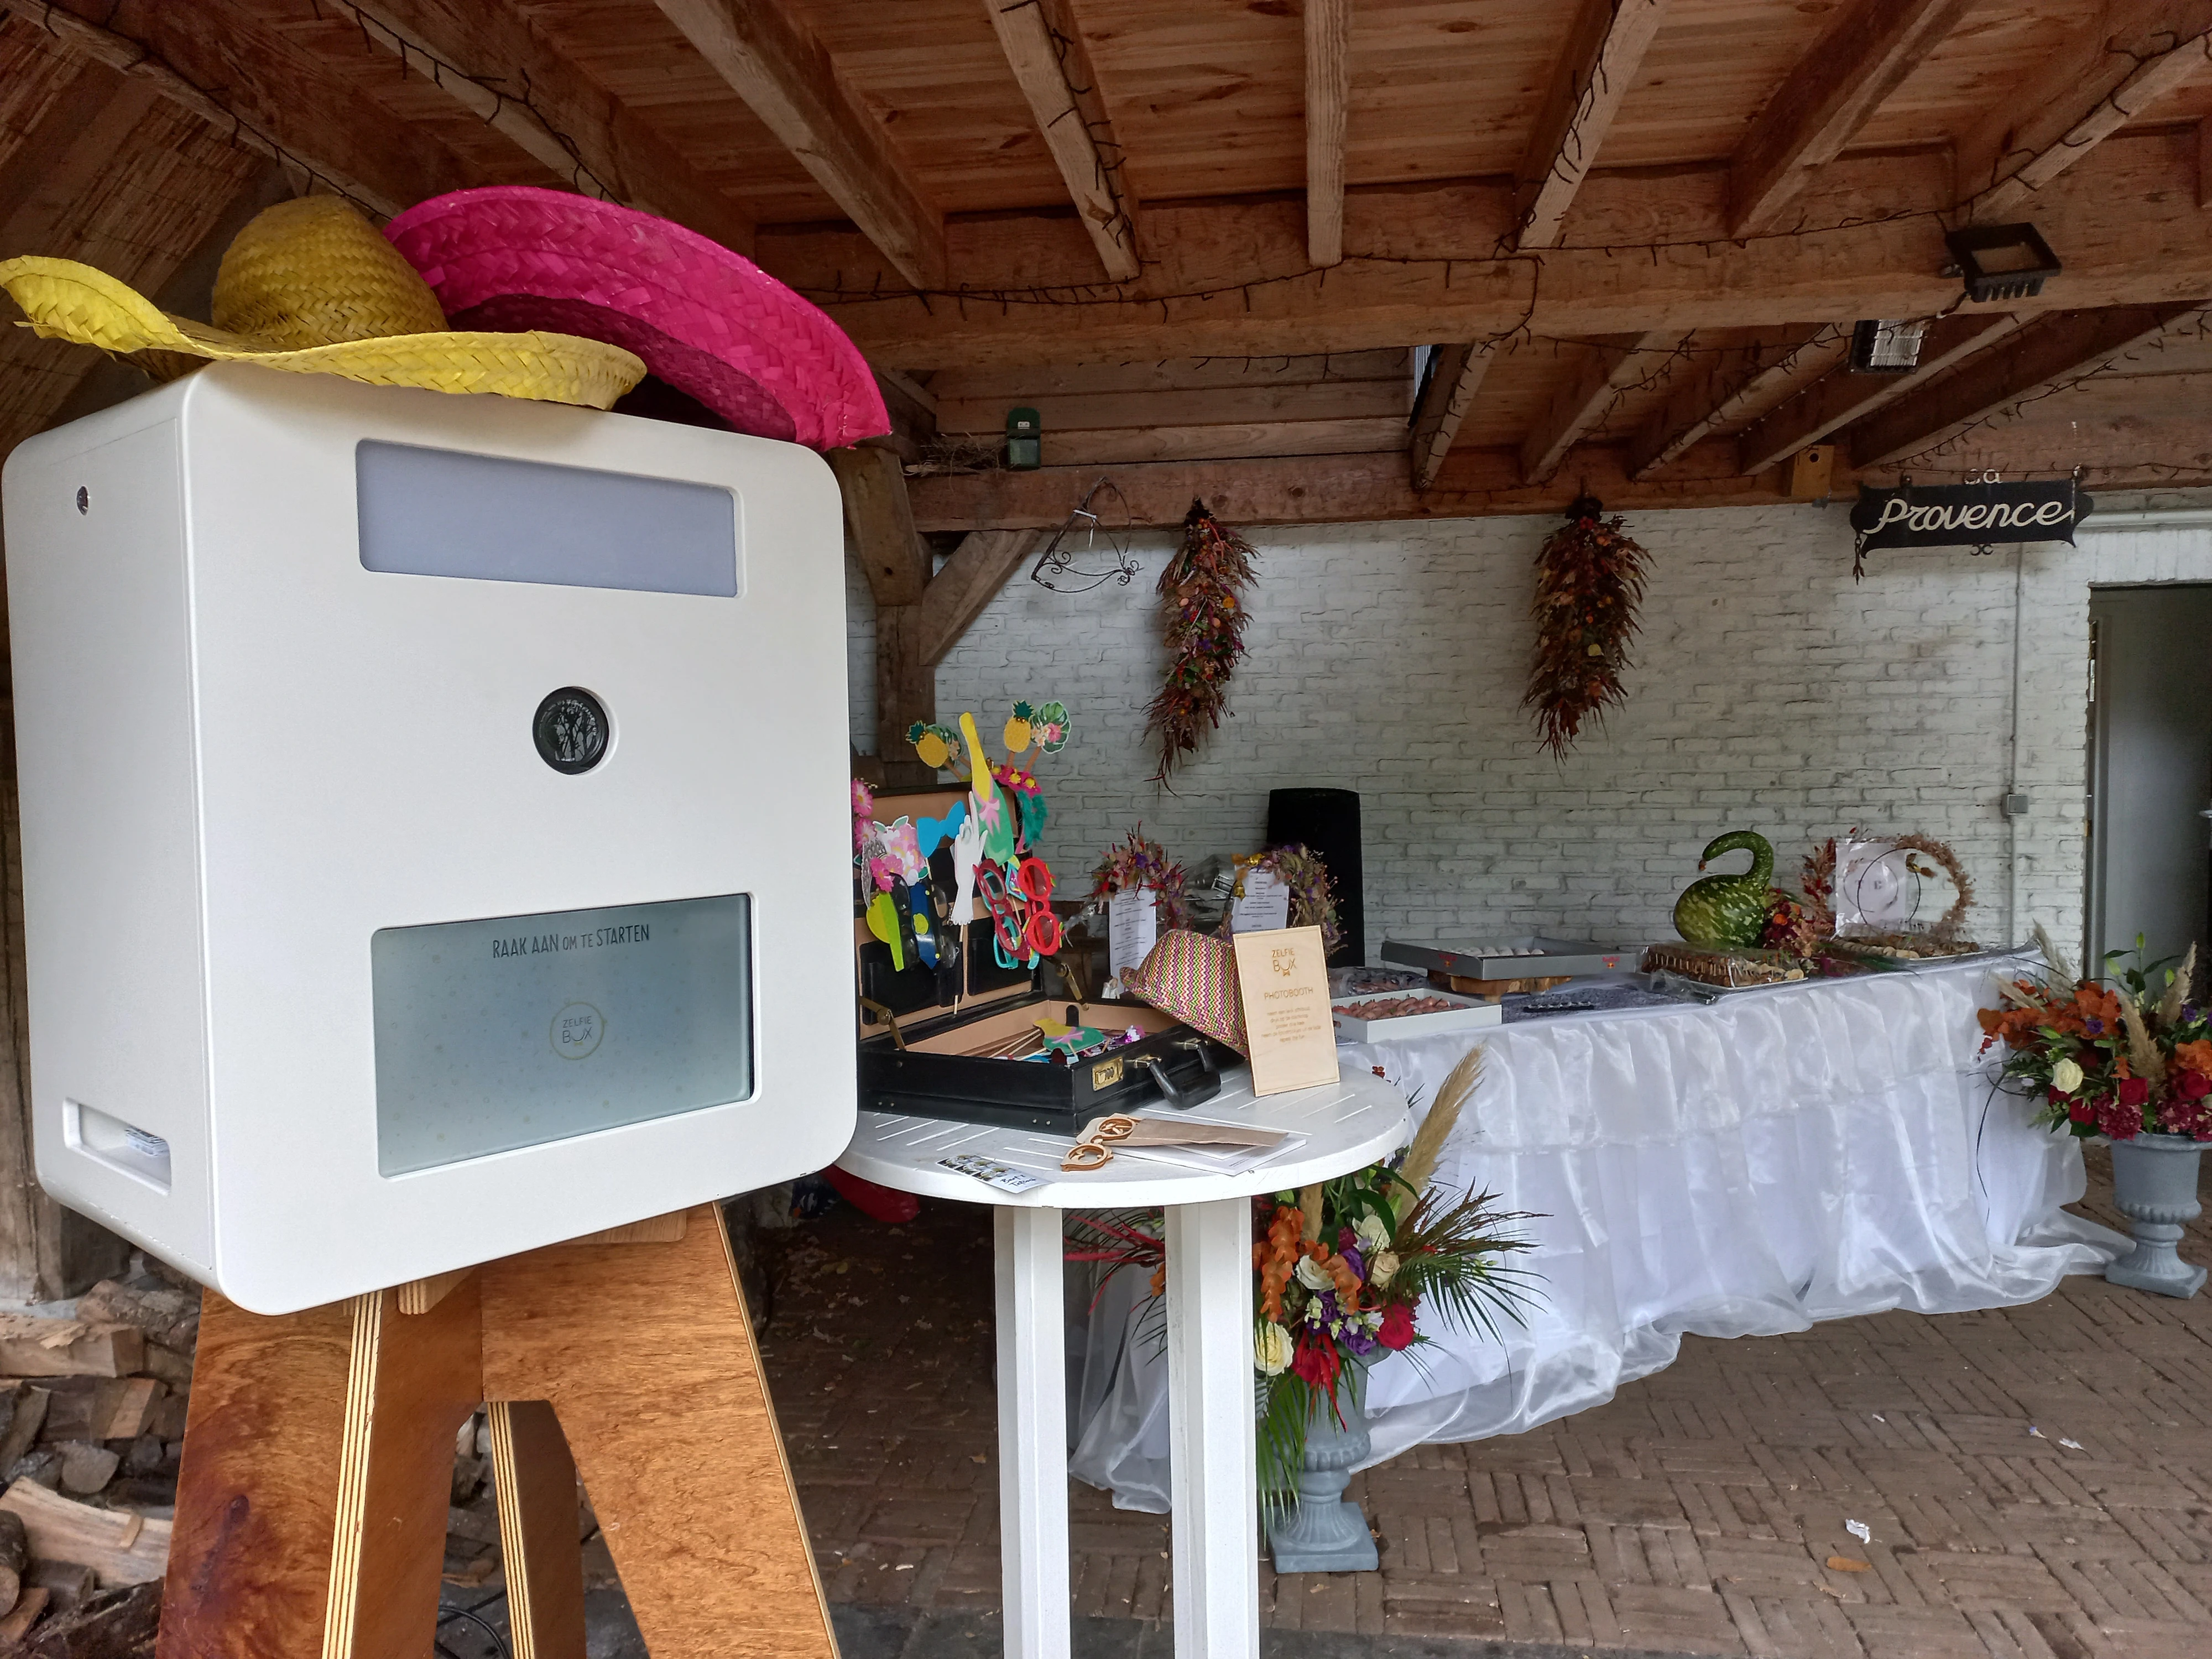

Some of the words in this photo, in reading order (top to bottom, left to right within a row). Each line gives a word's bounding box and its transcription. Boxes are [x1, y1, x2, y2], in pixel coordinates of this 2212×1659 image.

[1863, 498, 2075, 534] Provence
[493, 937, 527, 958] RAAK
[531, 933, 559, 954] AAN
[562, 936, 577, 950] OM
[581, 933, 593, 948] TE
[597, 924, 650, 947] STARTEN
[1272, 948, 1295, 957] ZELFIE
[1264, 987, 1313, 999] PHOTOBOOTH
[562, 1016, 592, 1028] ZELFIE
